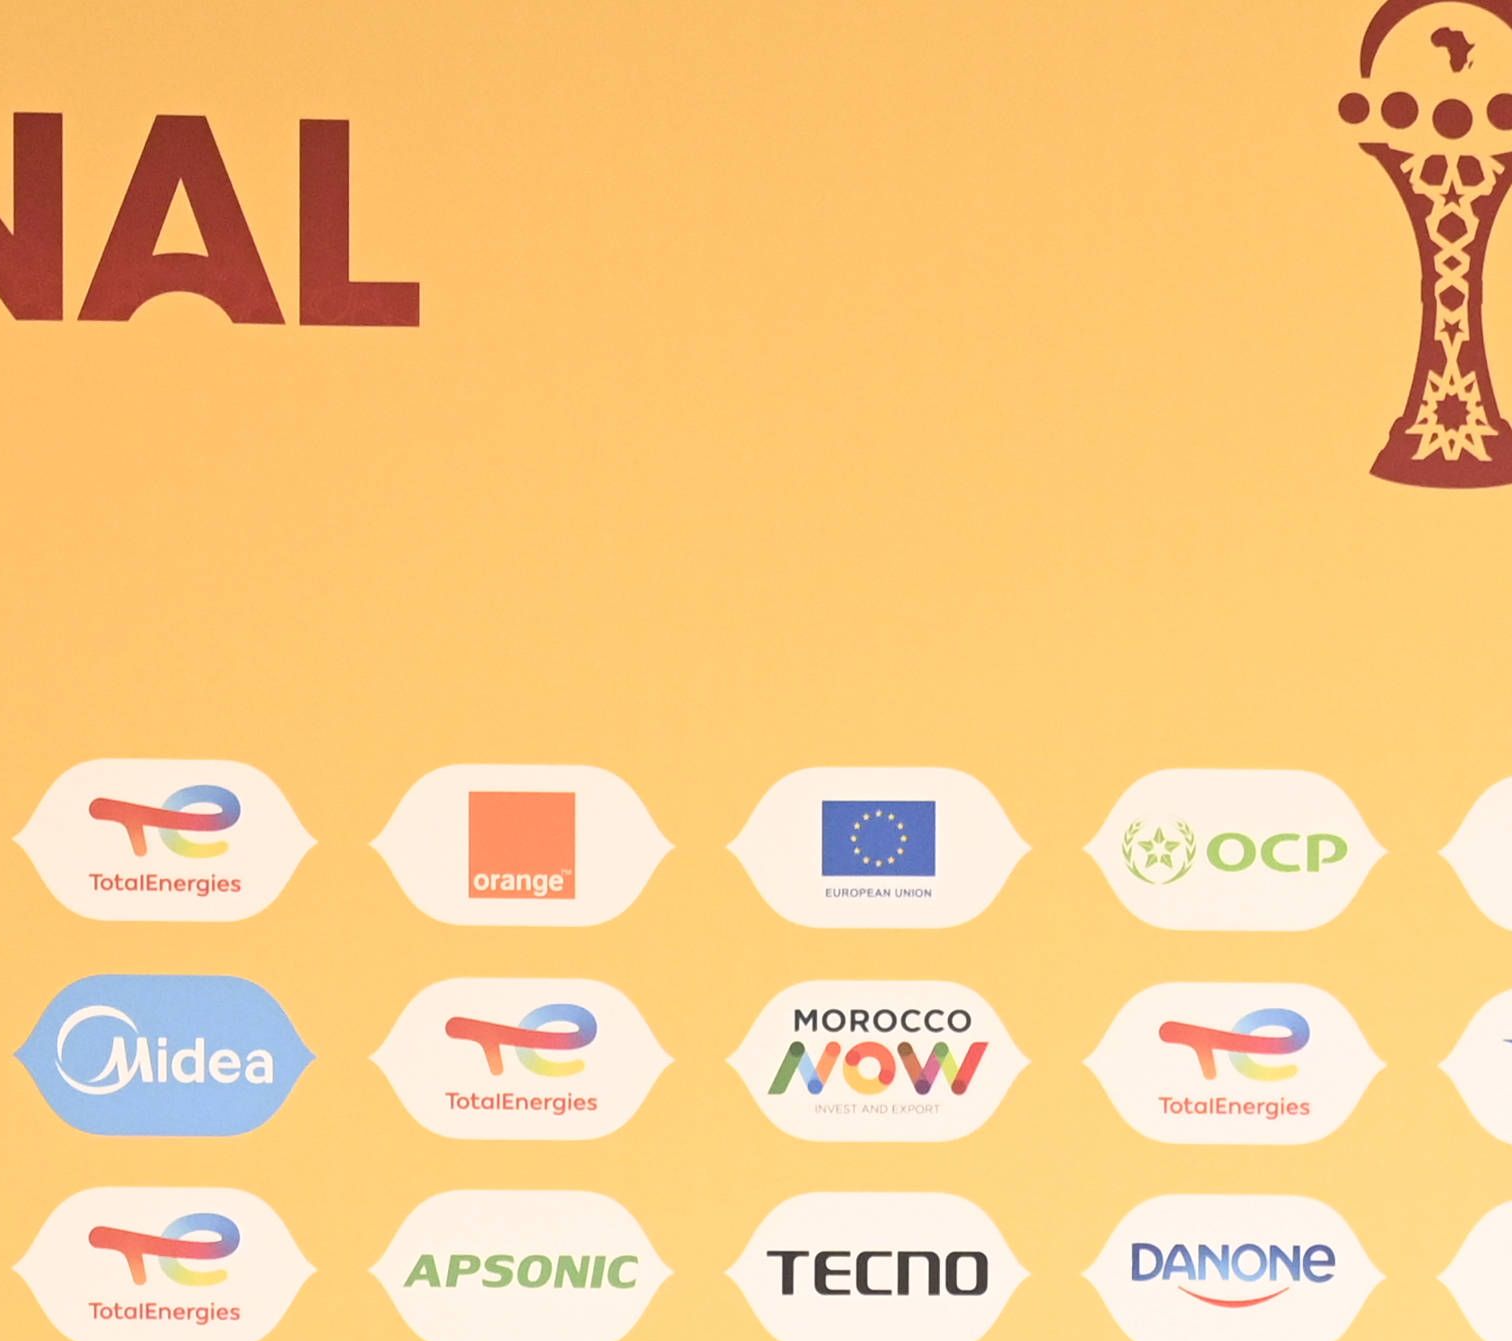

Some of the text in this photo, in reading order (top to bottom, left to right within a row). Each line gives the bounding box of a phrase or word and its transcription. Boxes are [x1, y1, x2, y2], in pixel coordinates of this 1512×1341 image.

[1207, 832, 1348, 872] OCP
[473, 871, 564, 896] orange
[825, 886, 933, 899] EUROPEAN UNION
[795, 1009, 971, 1032] MOROCCO
[100, 1034, 273, 1087] Midea
[768, 1041, 988, 1095] NOW
[814, 1103, 940, 1115] INVEST AND EXPORT
[404, 1254, 638, 1288] APSONIC
[767, 1251, 988, 1295] TECNO
[1132, 1243, 1335, 1283] DANONE
